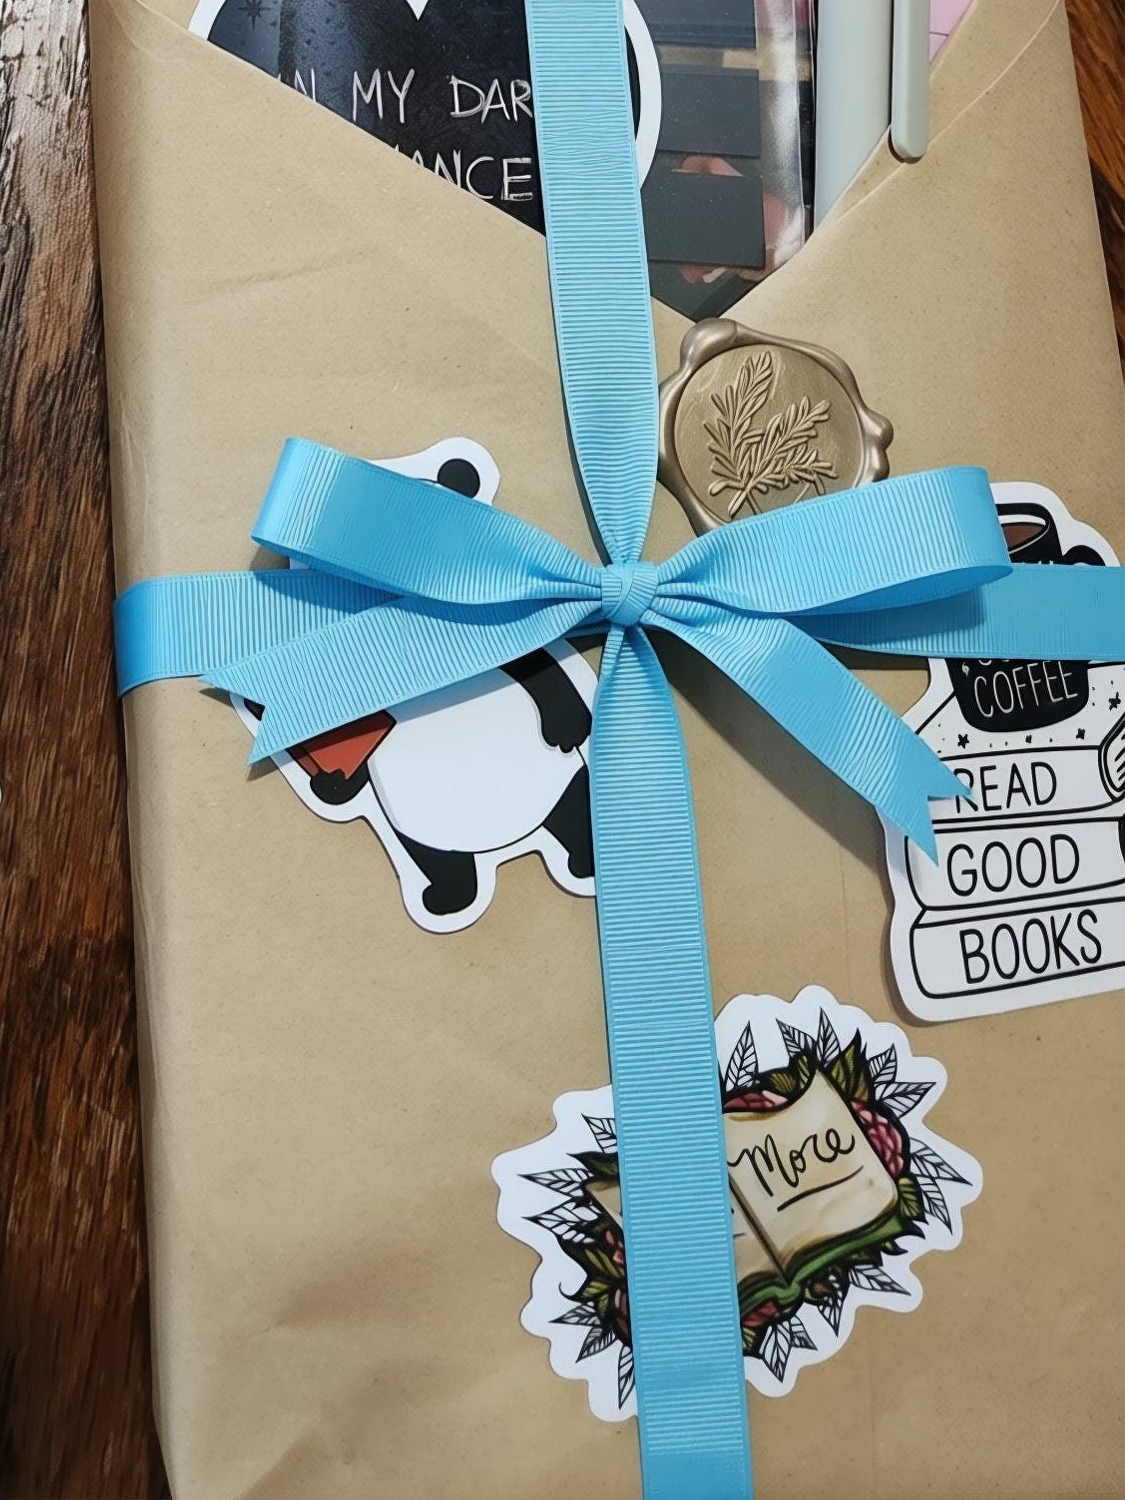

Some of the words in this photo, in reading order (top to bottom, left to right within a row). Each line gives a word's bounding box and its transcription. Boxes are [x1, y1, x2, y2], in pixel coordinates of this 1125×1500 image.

[352, 68, 415, 123] MY
[450, 75, 533, 123] DAR
[974, 660, 1078, 718] COFFEE
[953, 761, 1057, 814] READ
[946, 833, 1081, 898] GOOD
[958, 908, 1103, 985] BOOKS
[727, 1126, 856, 1197] More
